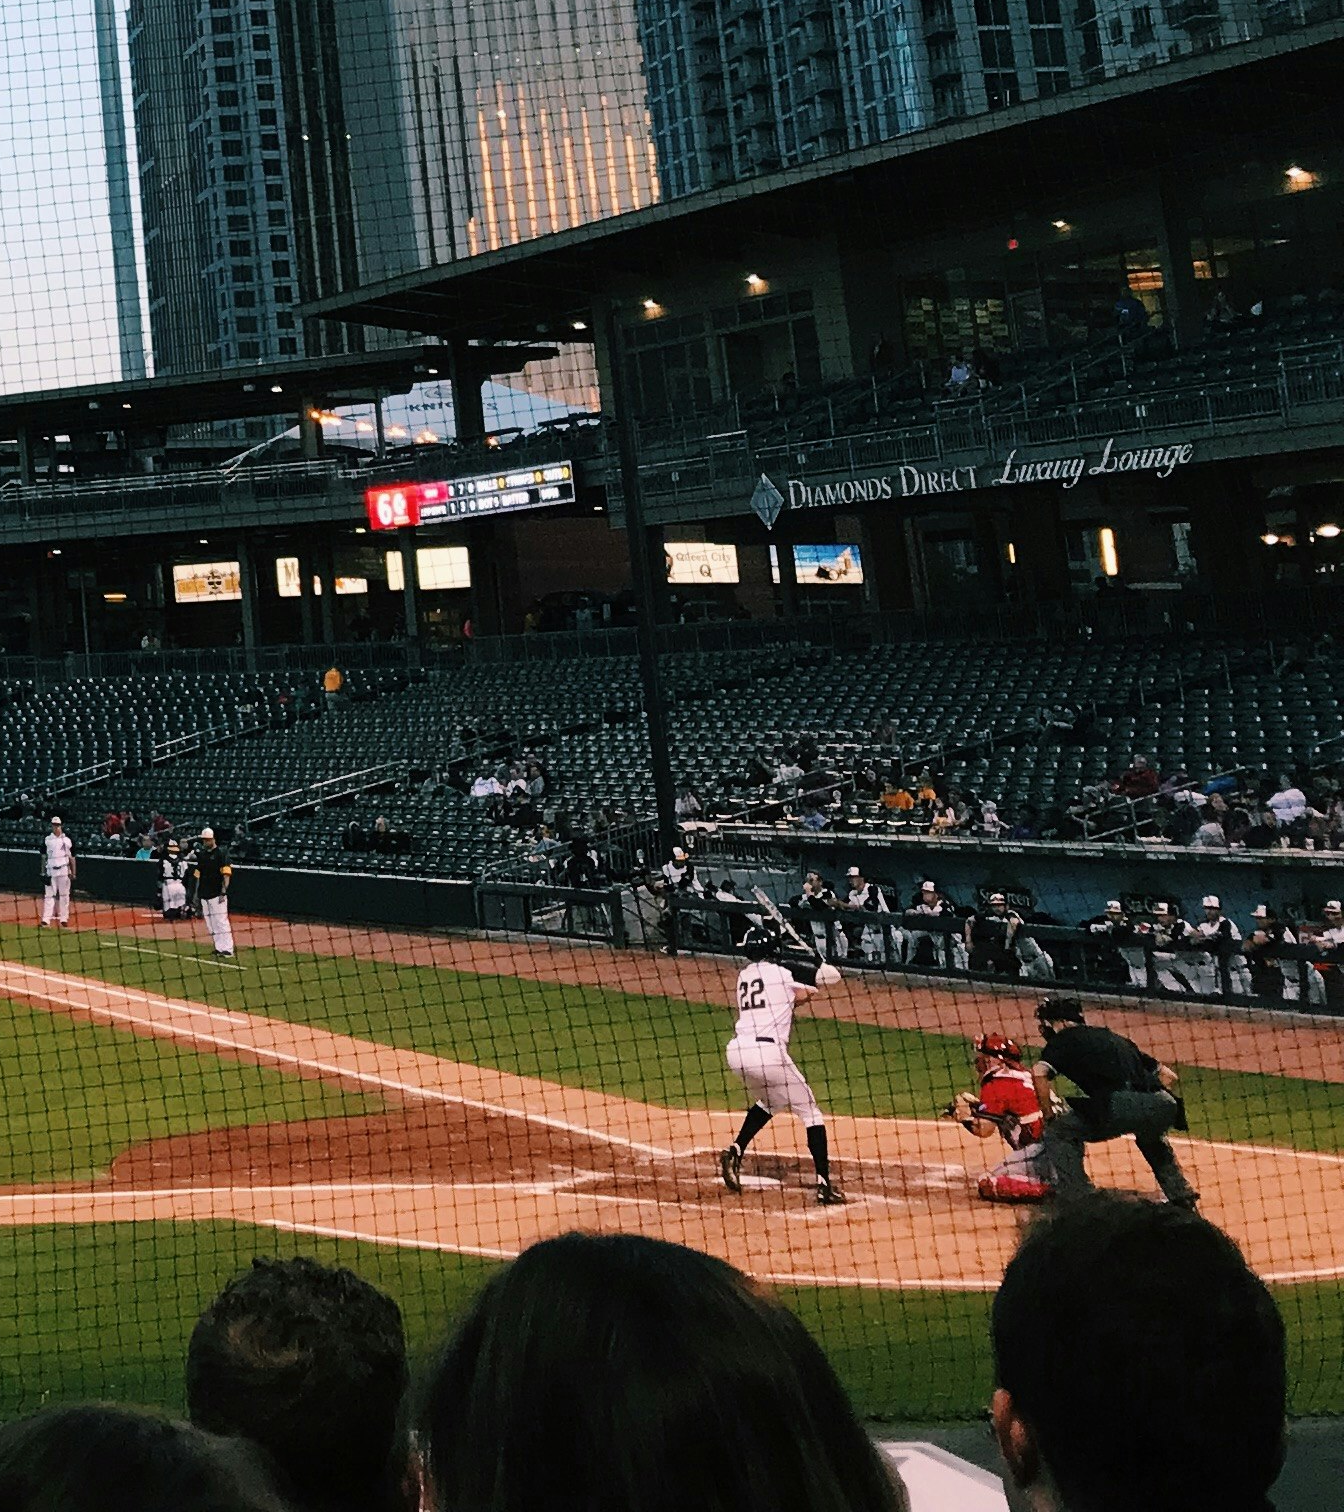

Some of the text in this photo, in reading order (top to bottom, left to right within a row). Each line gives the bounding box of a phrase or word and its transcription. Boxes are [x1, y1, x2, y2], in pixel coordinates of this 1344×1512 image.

[992, 450, 1086, 489] Luxury
[1088, 438, 1193, 478] Lounge
[675, 552, 730, 563] Queen City
[699, 564, 711, 578] Q
[739, 977, 766, 1011] 22
